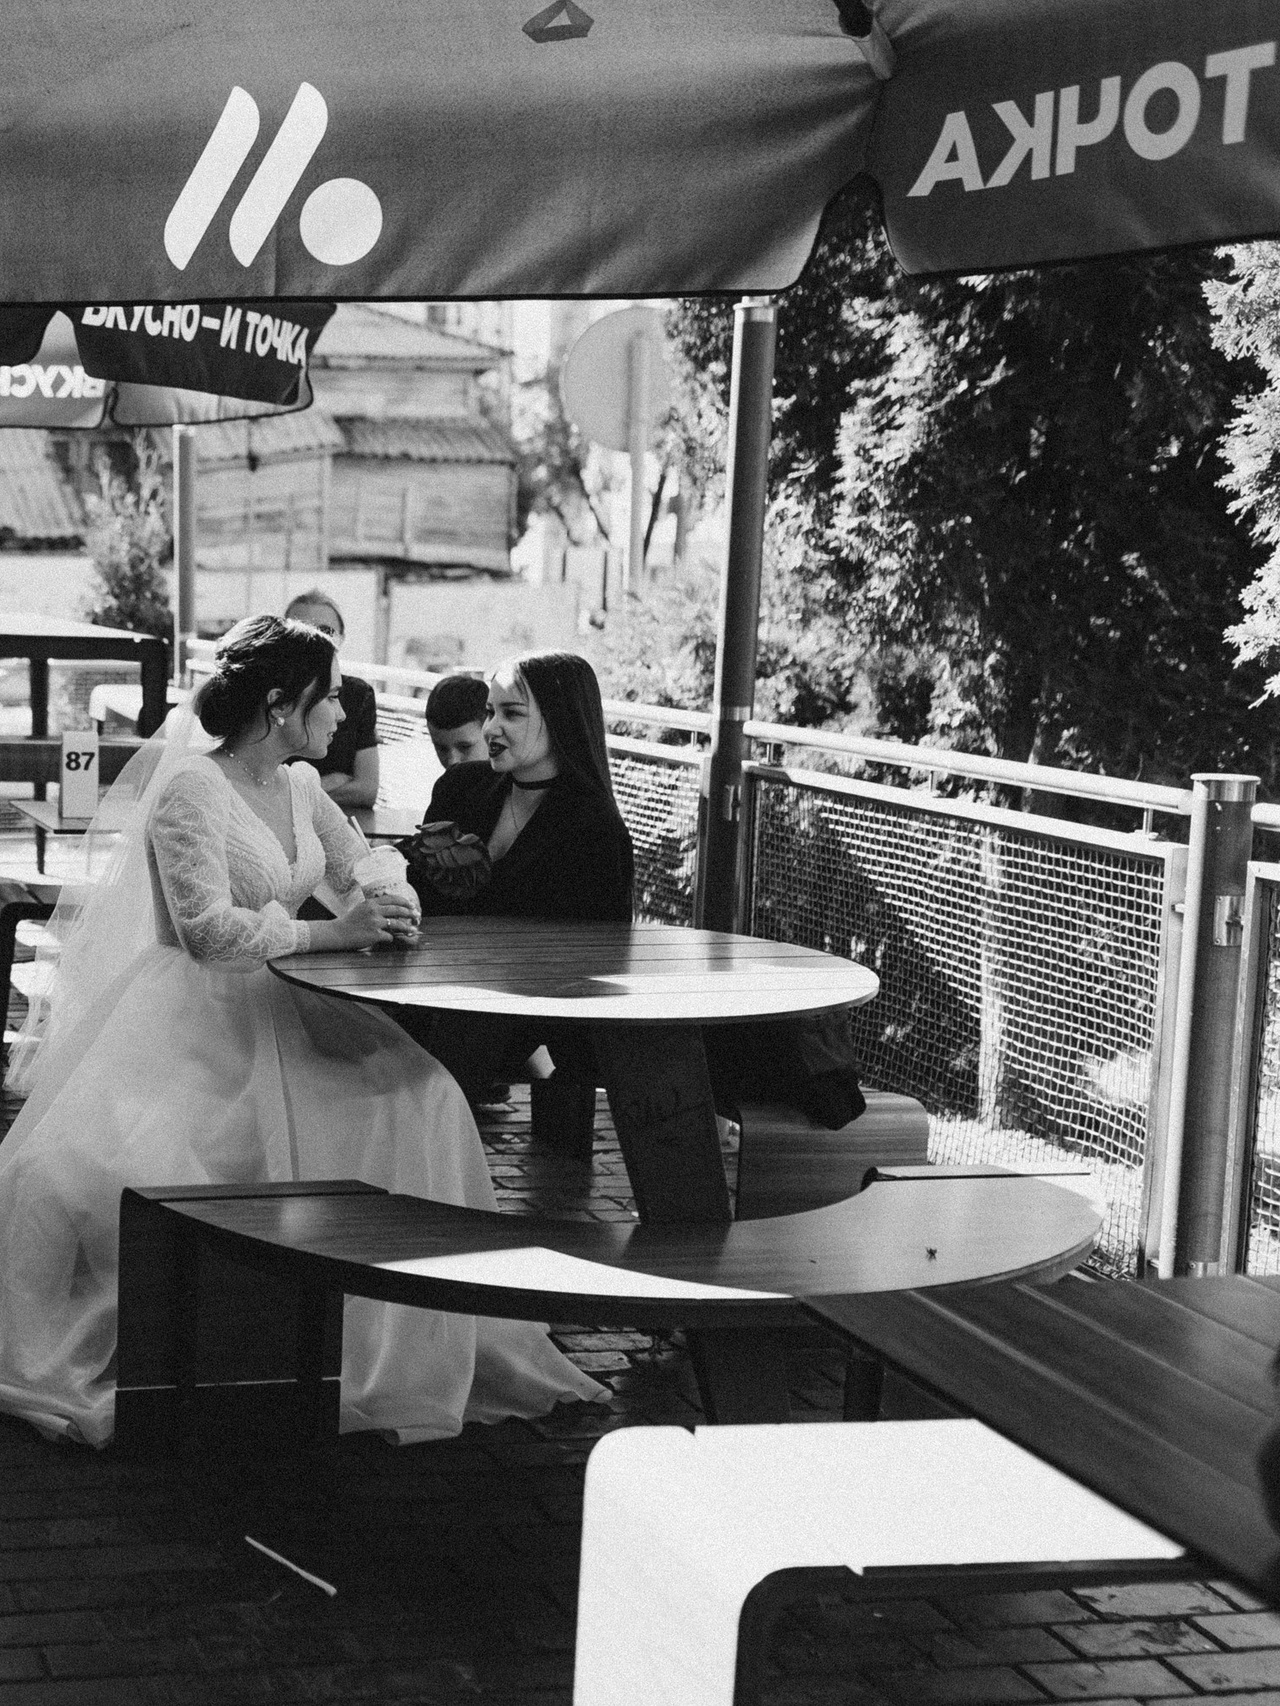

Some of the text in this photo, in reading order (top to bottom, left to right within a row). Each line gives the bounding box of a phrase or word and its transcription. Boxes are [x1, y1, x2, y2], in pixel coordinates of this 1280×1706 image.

[220, 305, 242, 350] И
[245, 310, 309, 368] ТОЧКА
[66, 751, 95, 771] 87
